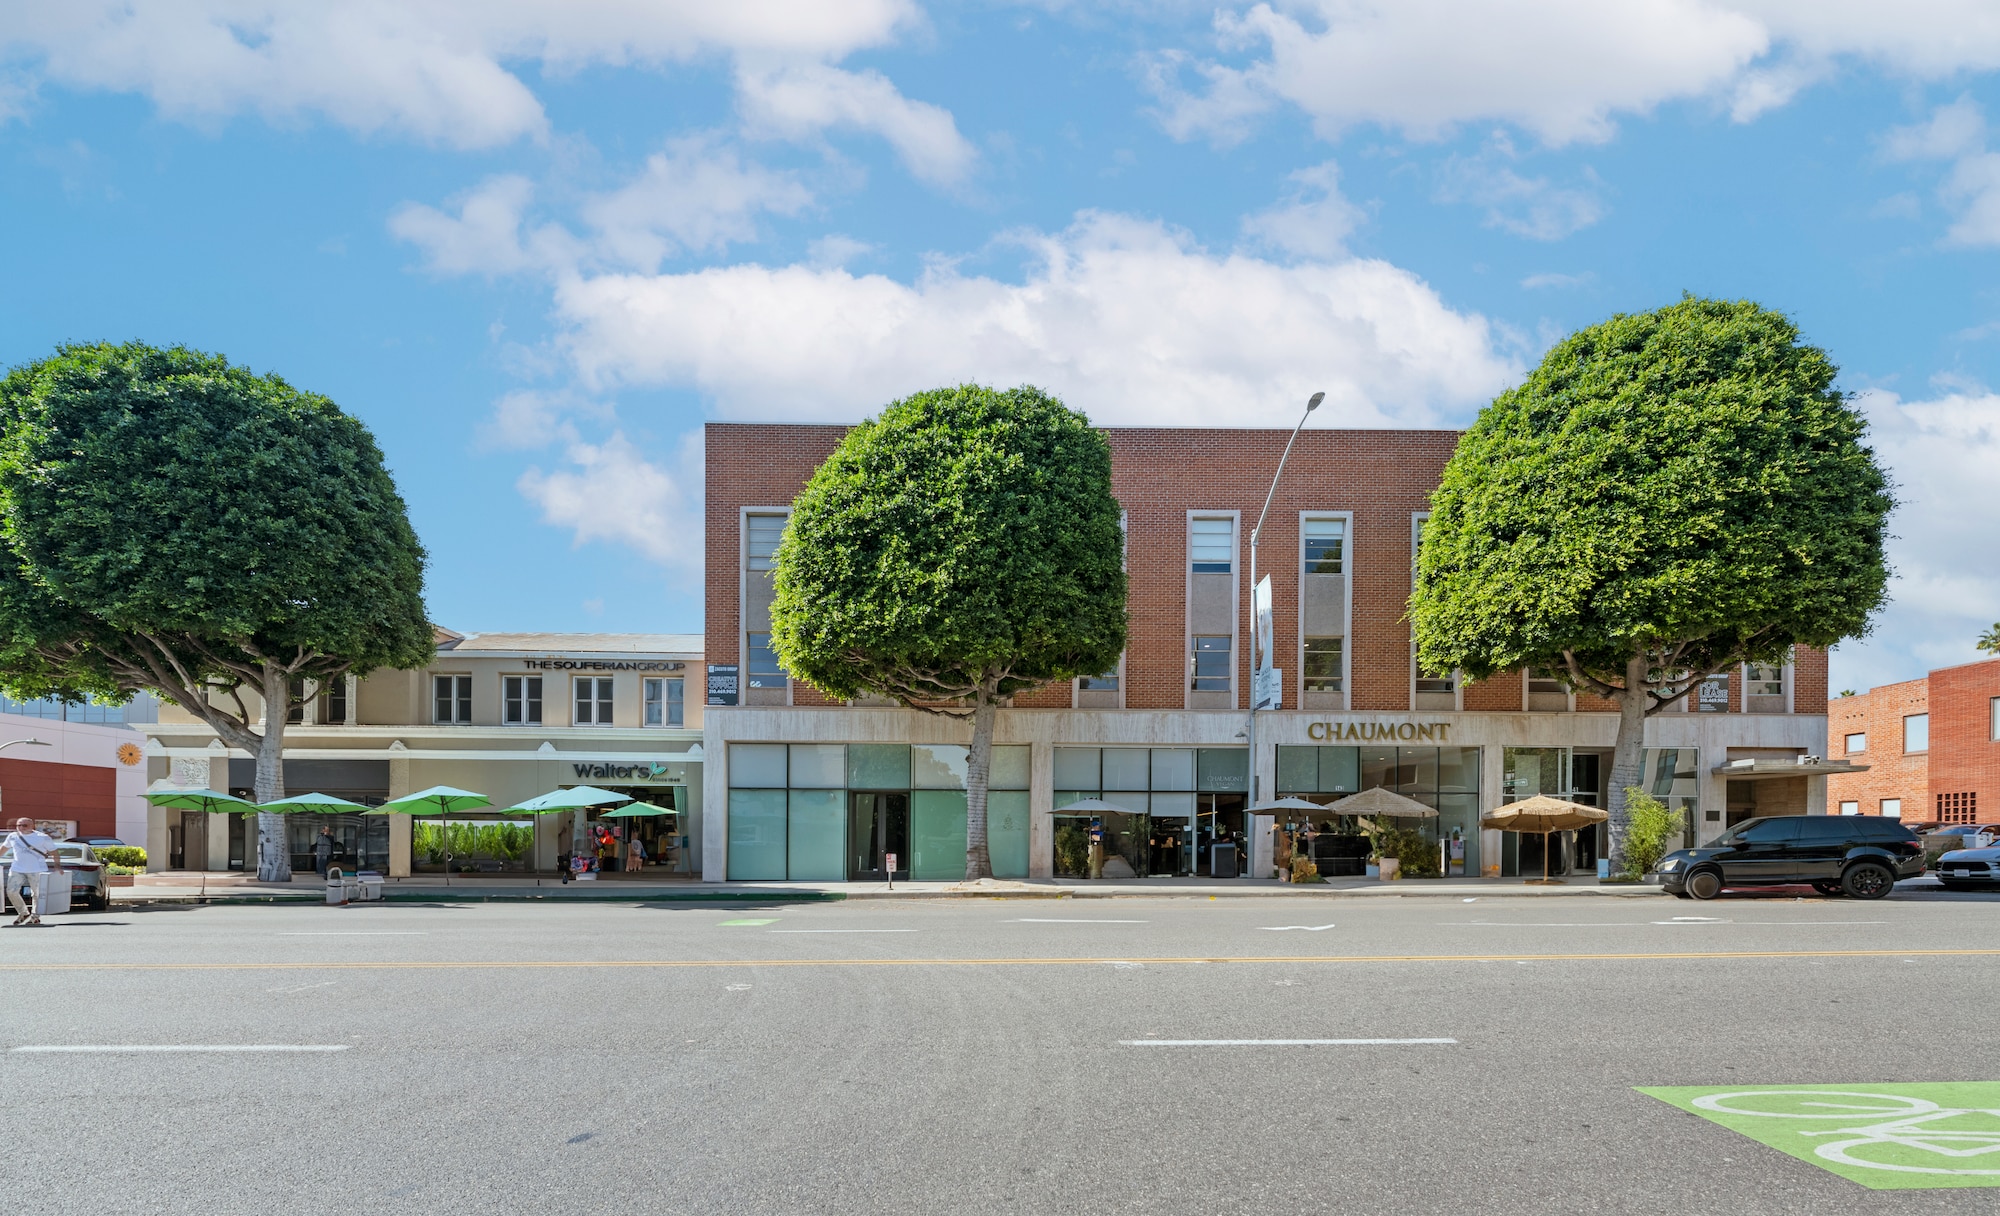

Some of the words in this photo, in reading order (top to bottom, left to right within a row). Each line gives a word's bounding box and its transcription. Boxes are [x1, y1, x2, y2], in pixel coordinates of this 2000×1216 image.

[1699, 681, 1720, 690] FOR
[1699, 689, 1729, 699] LEASE
[1307, 722, 1451, 741] CHAUMONT
[573, 763, 650, 779] Walter's
